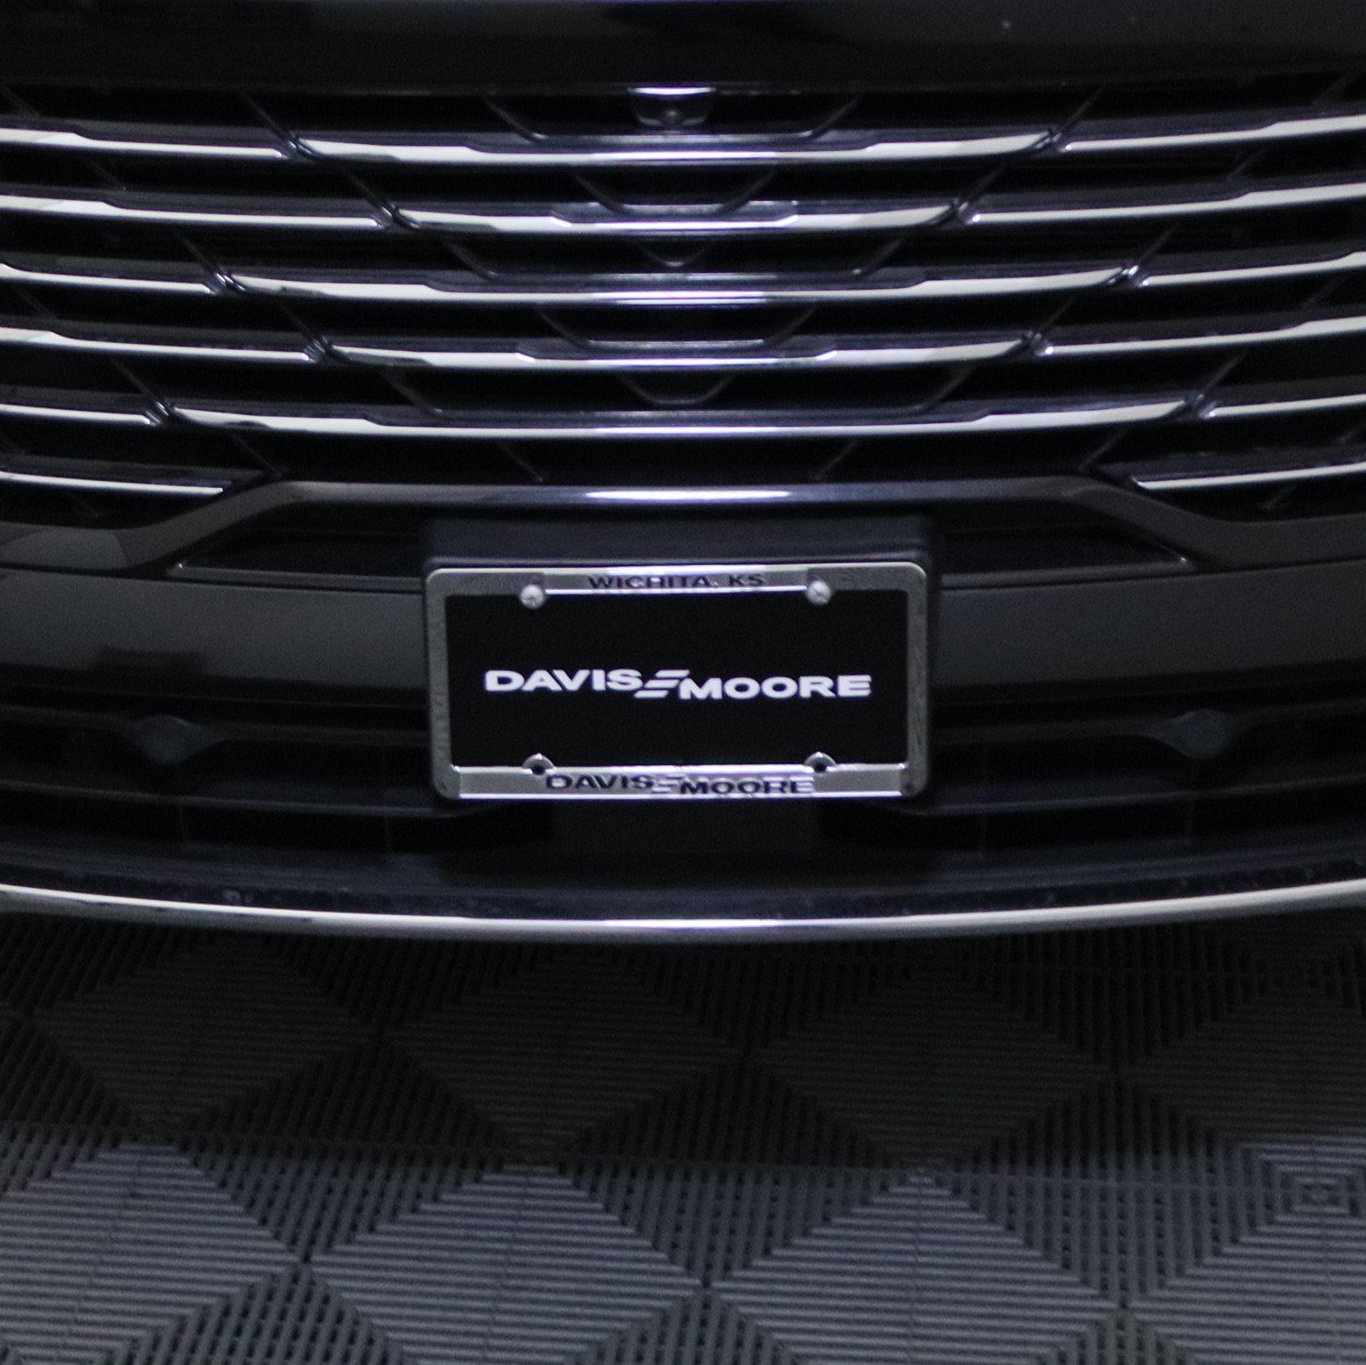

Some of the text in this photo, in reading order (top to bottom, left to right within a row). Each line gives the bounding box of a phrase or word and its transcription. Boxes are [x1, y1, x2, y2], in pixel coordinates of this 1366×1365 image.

[728, 573, 764, 587] KS
[485, 669, 872, 700] DAVIS MOORE
[545, 774, 815, 795] DAVIS MOORE
